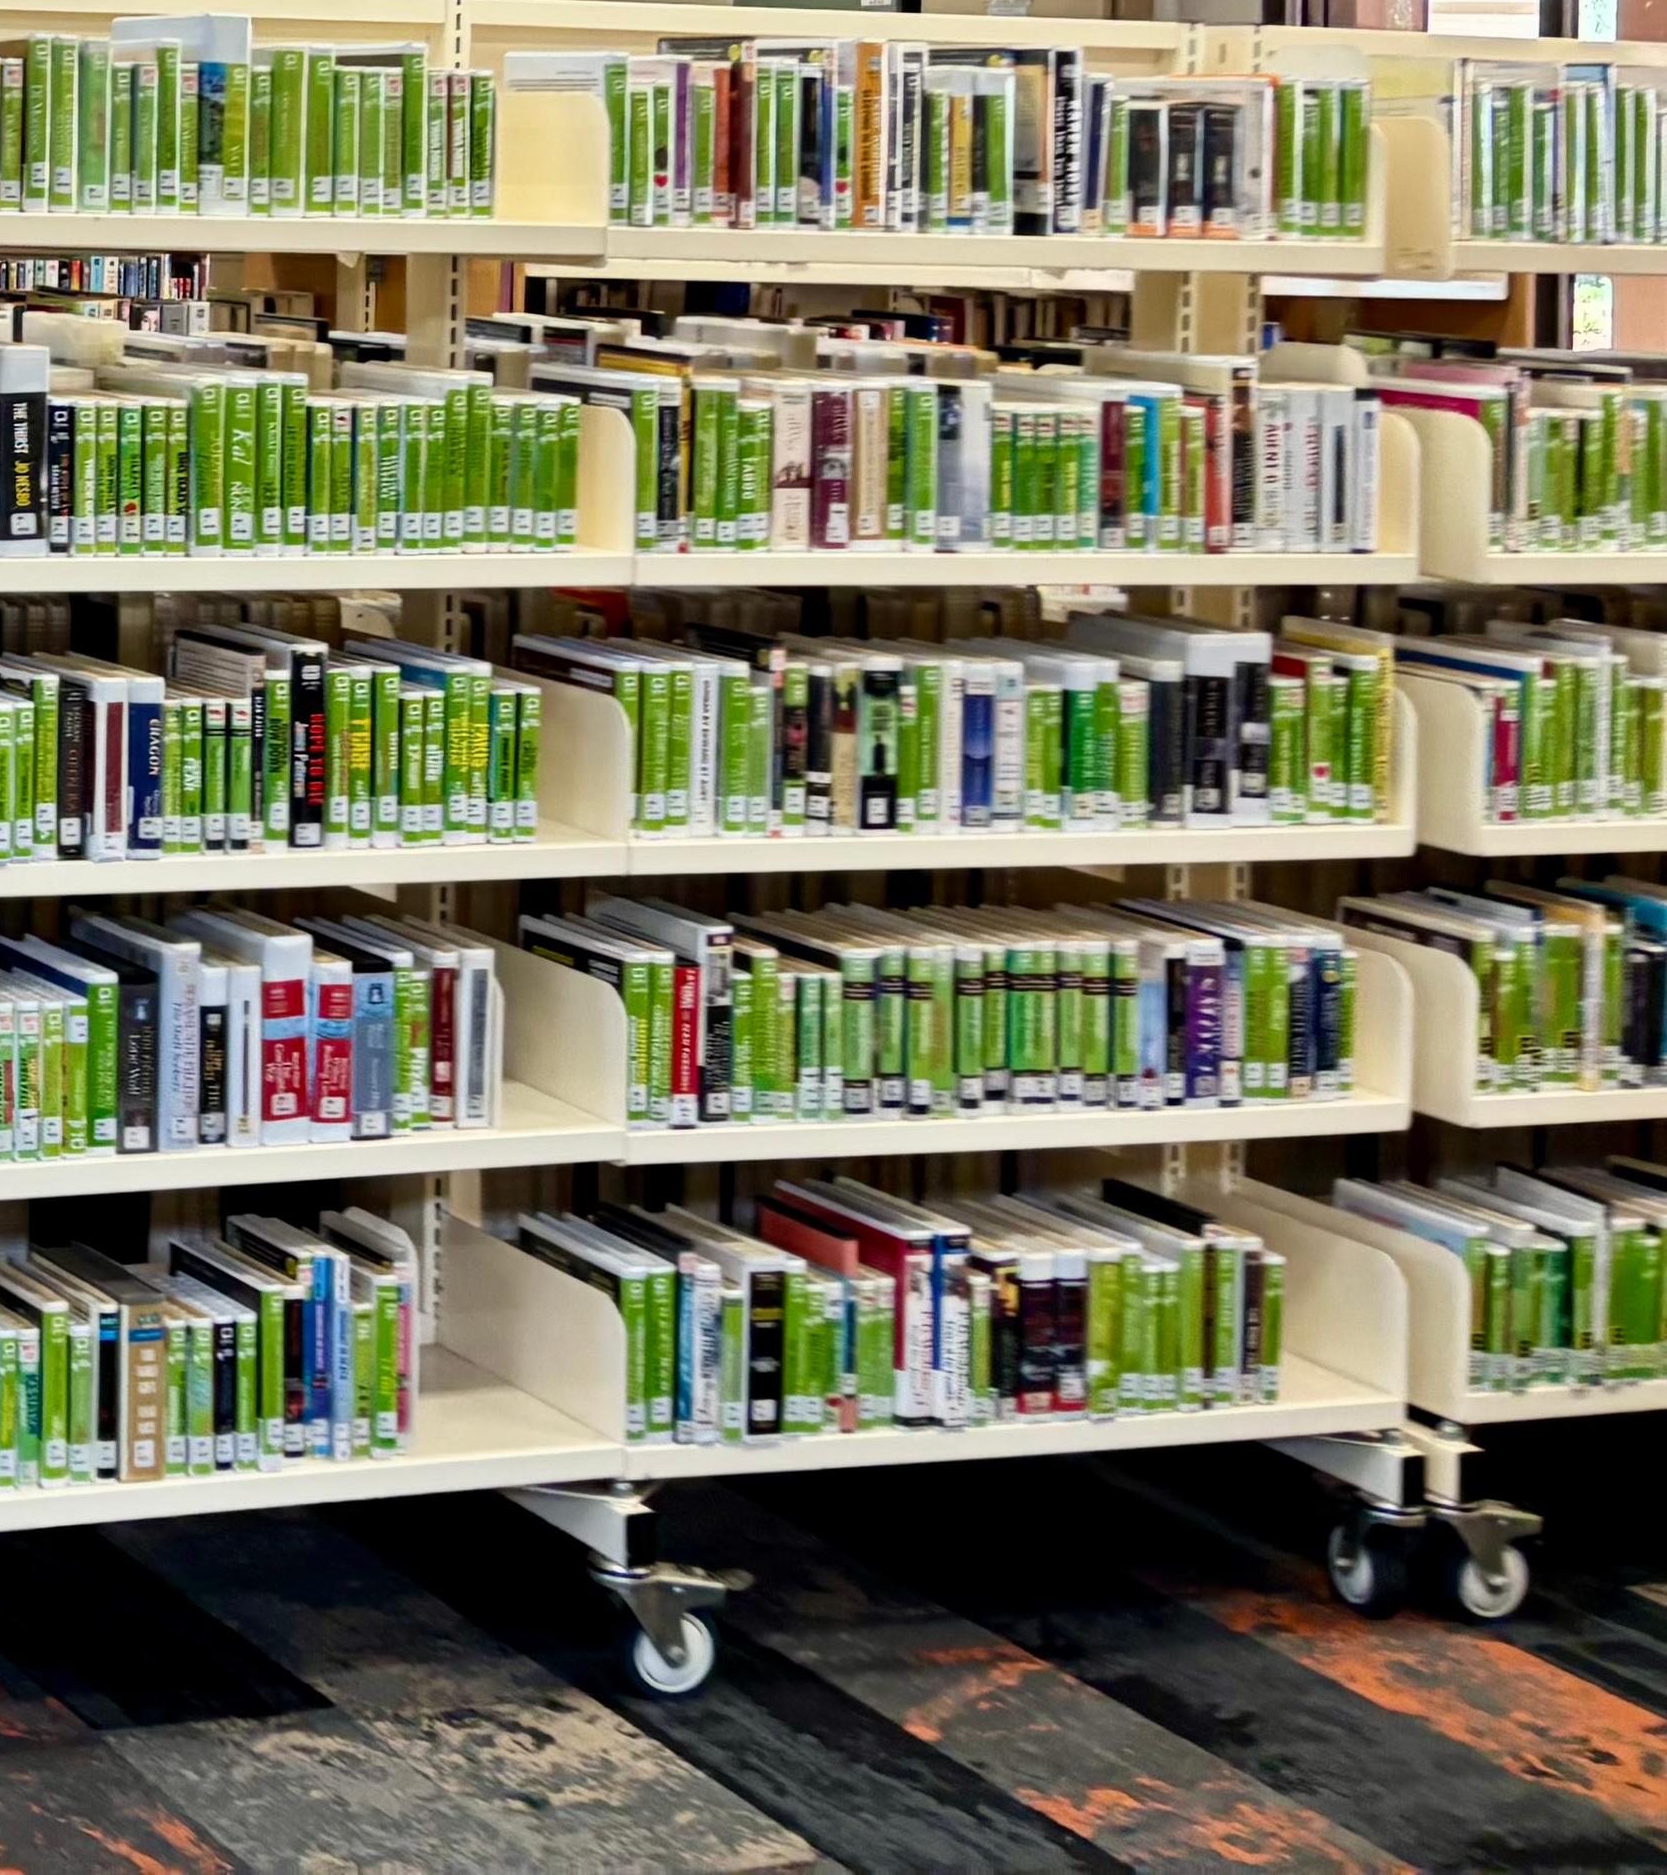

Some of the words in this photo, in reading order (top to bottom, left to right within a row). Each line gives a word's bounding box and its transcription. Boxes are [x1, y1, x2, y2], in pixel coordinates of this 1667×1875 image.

[12, 402, 28, 420] THE
[12, 422, 29, 454] THIRST
[231, 428, 253, 465] Kal
[14, 460, 32, 473] JO
[127, 1068, 141, 1095] Wolf
